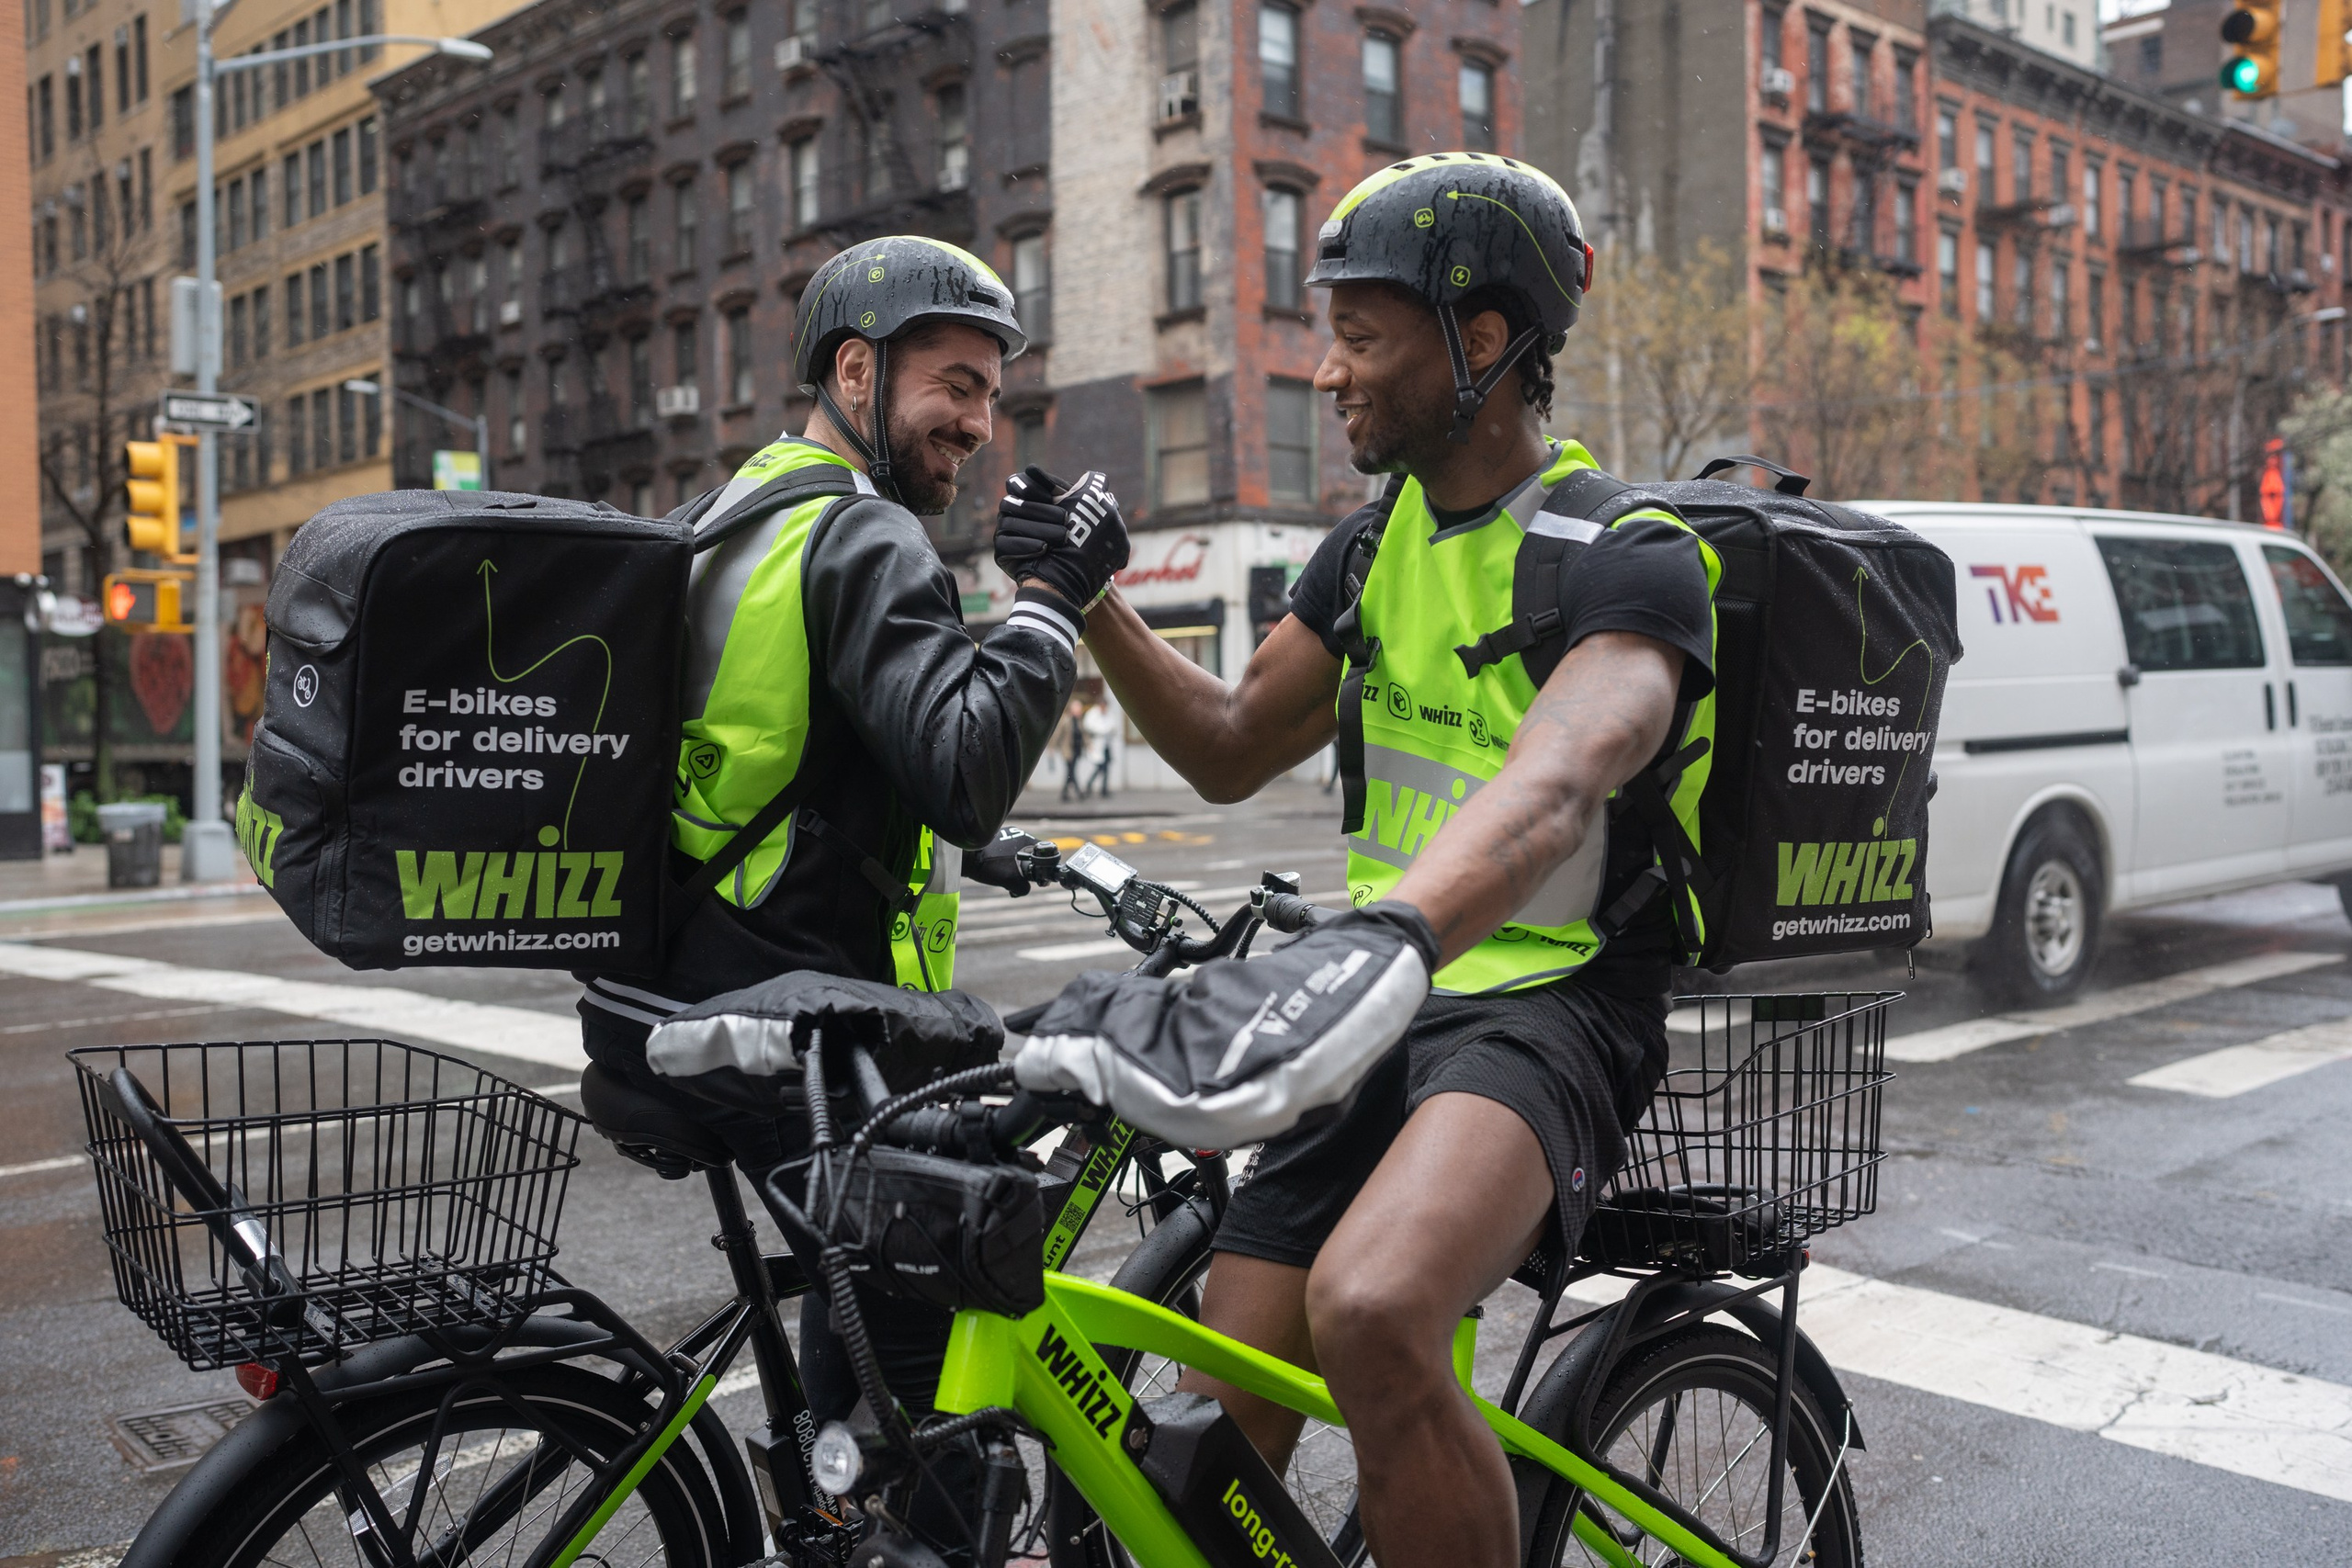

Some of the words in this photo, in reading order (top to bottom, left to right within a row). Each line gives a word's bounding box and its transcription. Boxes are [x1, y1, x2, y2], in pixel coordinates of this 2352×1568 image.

[1970, 566, 2060, 623] TKE
[403, 687, 557, 716] E-bikes
[1796, 689, 1901, 716] E-bikes
[400, 724, 460, 751] for
[472, 726, 630, 760] delivery
[1793, 723, 1838, 750] for
[1844, 725, 1931, 755] delivery
[398, 761, 544, 790] drivers
[1787, 758, 1886, 785] drivers
[1772, 913, 1911, 941] getwhizz.com
[402, 929, 620, 956] getwhizz.com
